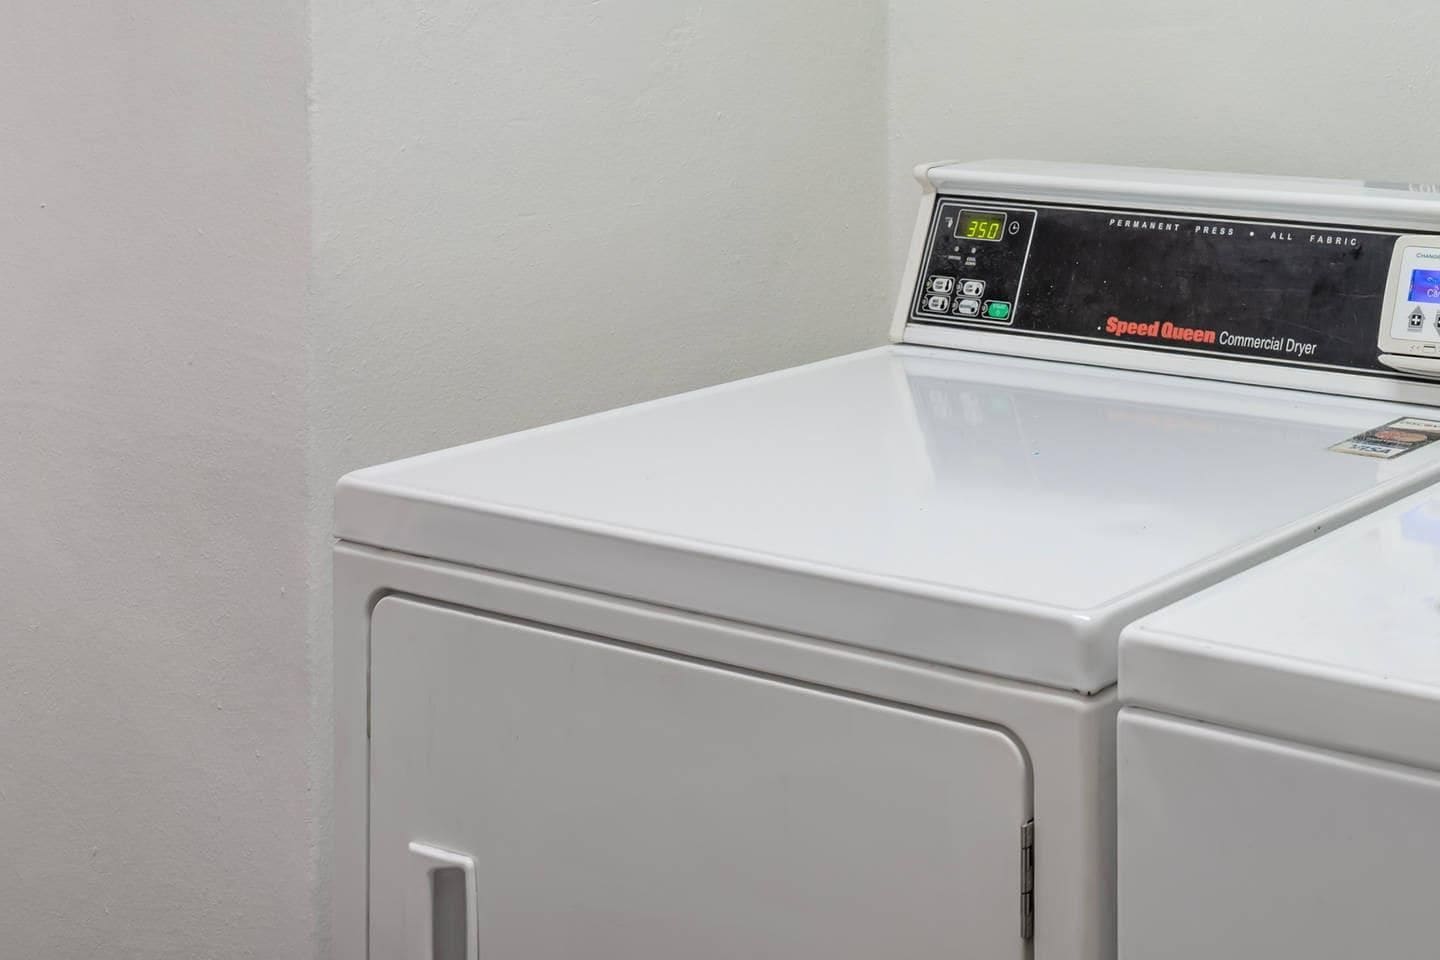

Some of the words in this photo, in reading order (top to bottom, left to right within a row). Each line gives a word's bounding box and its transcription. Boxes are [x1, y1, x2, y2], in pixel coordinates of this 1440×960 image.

[967, 220, 999, 239] 350
[1109, 218, 1181, 231] PERMANENT
[1195, 225, 1235, 236] PRESS
[1270, 232, 1293, 241] ALL
[1309, 234, 1358, 246] FABRIC
[1105, 316, 1159, 337] Speed
[1161, 321, 1216, 344] Queen
[1219, 330, 1284, 352] Commercial
[1285, 337, 1318, 357] Dryer
